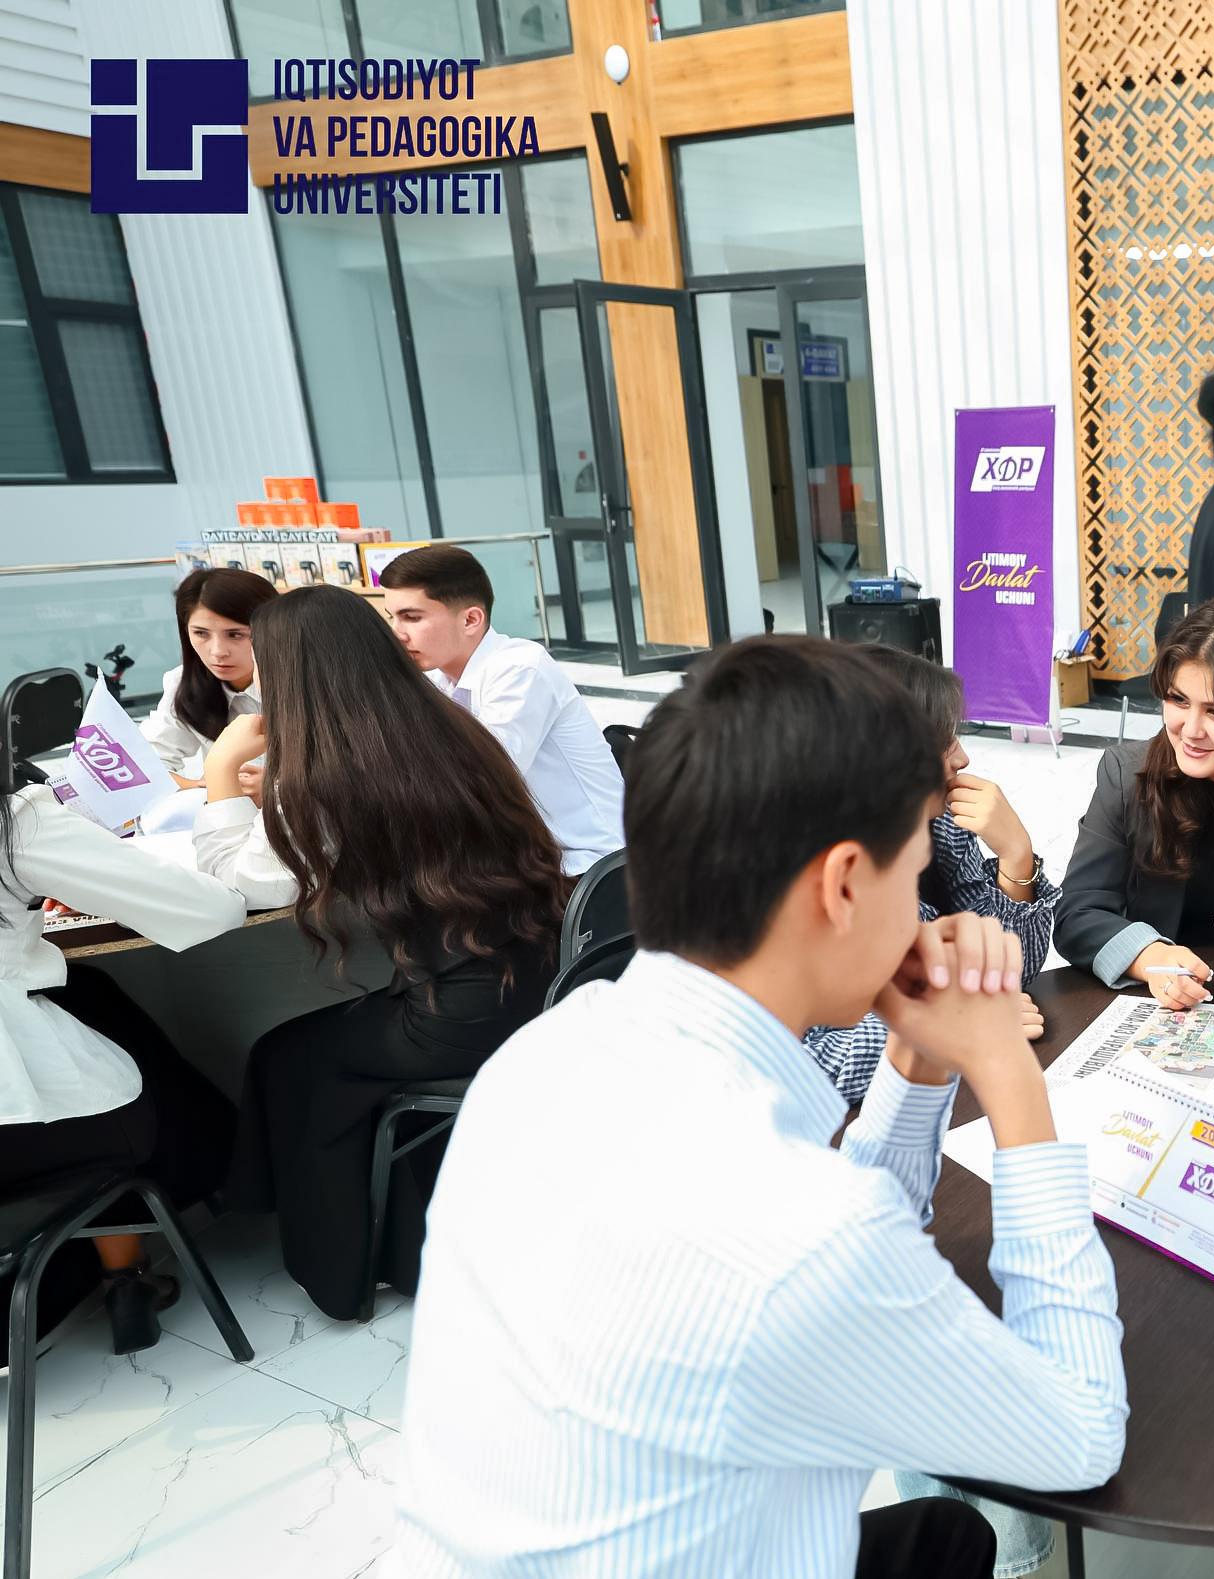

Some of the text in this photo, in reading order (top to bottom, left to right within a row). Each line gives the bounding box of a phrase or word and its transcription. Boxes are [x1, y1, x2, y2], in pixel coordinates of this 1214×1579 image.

[981, 456, 1034, 482] XDP
[959, 560, 1047, 591] Davlat
[76, 731, 134, 782] XDP
